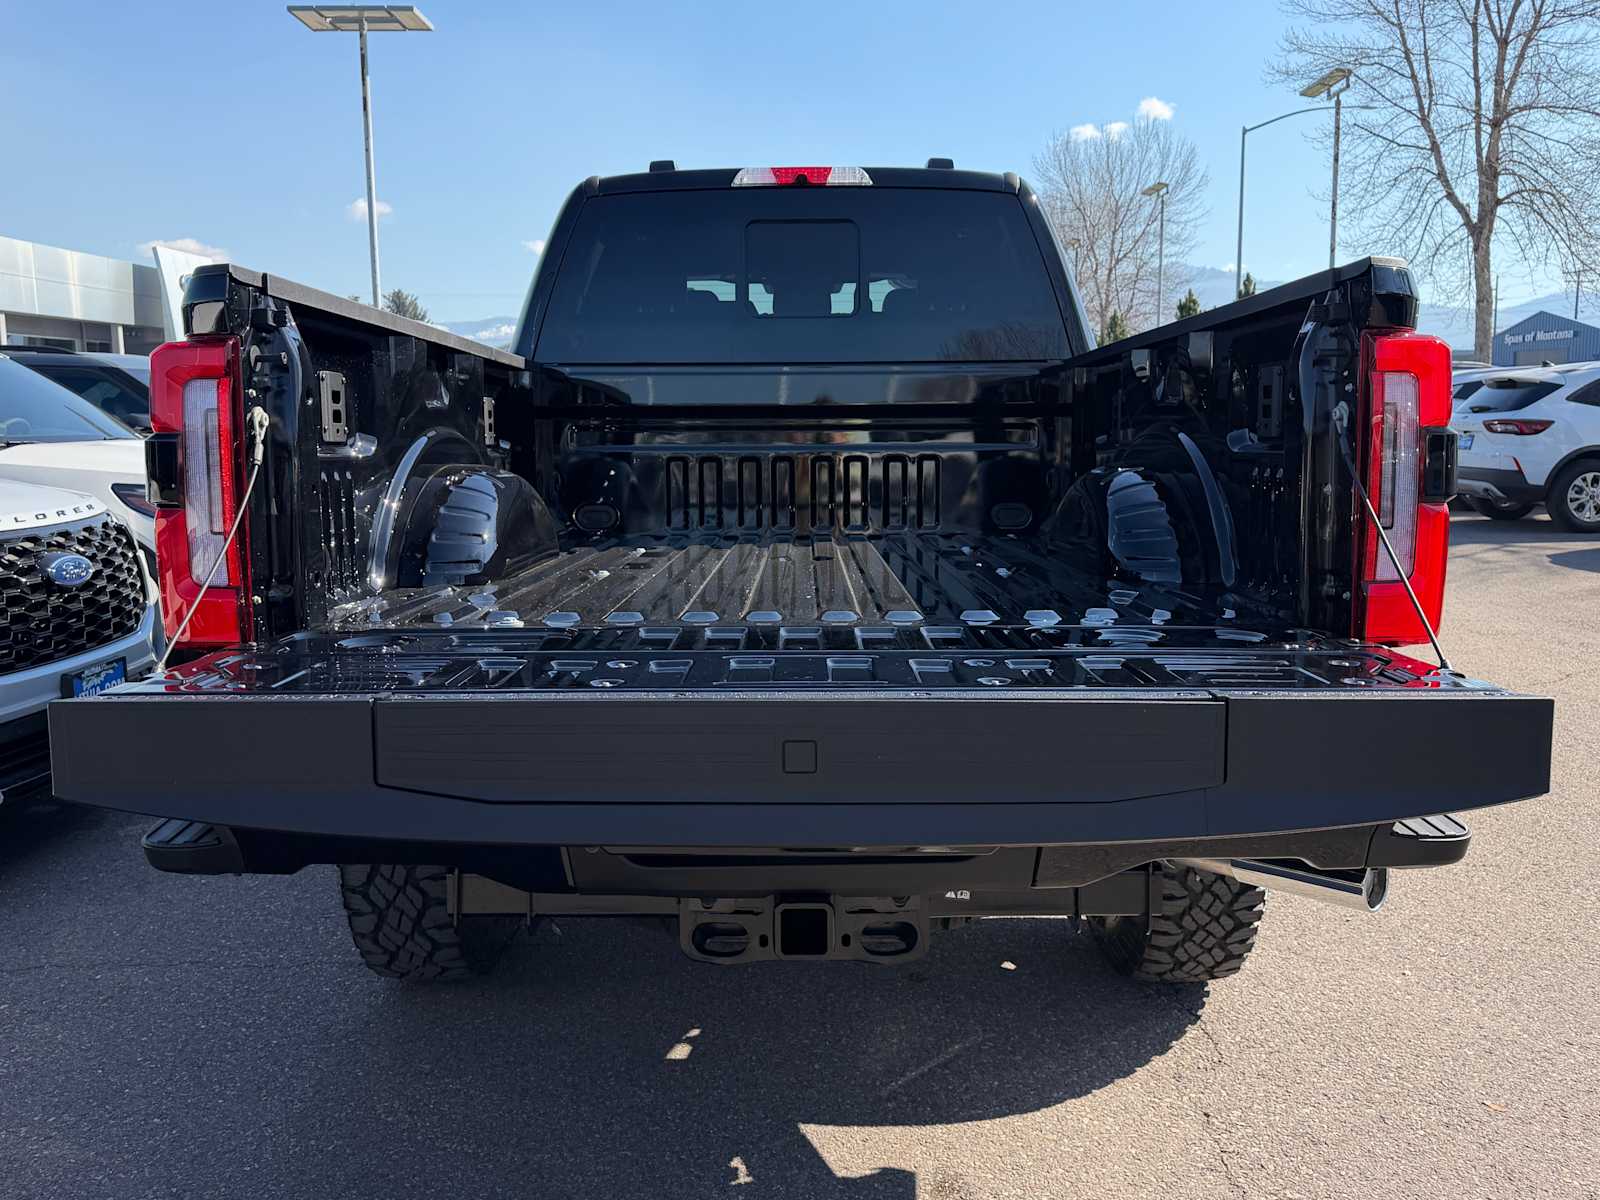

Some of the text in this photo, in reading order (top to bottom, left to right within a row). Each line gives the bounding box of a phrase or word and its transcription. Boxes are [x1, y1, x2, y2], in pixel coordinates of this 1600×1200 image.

[1504, 330, 1574, 346] Spas of Montana
[0, 503, 95, 522] LORER
